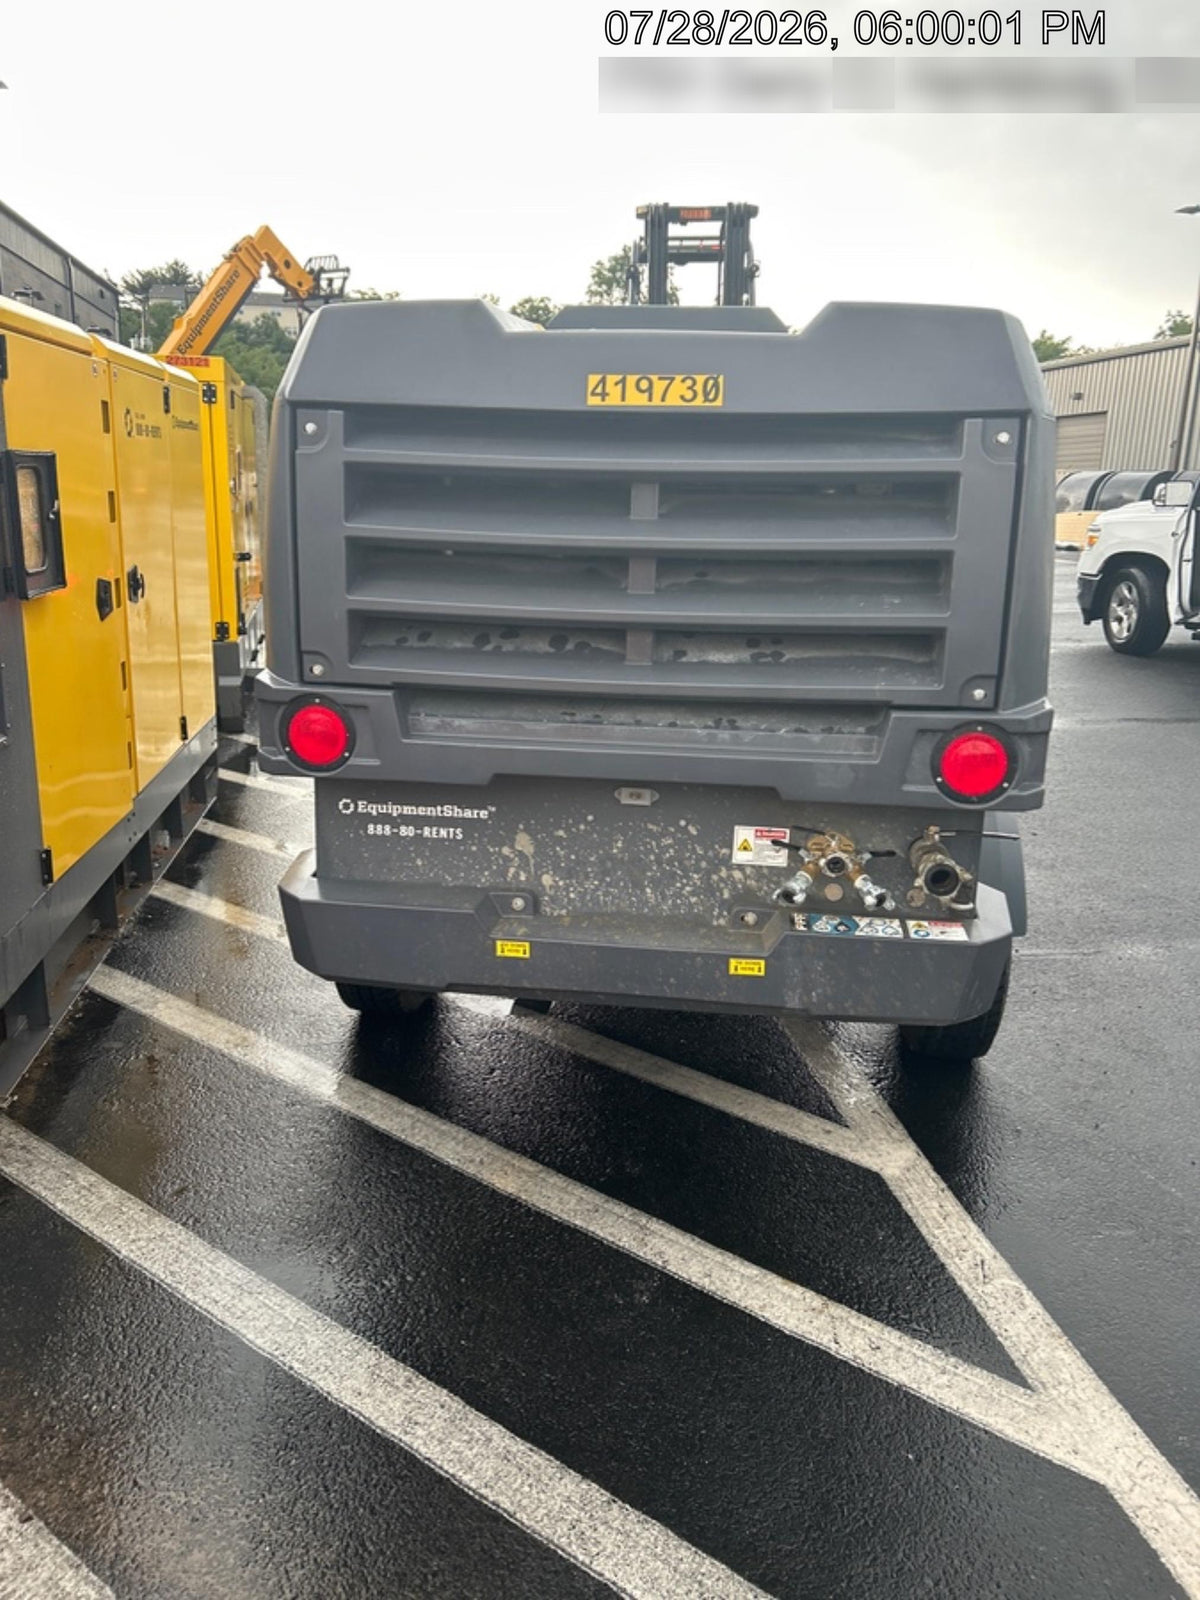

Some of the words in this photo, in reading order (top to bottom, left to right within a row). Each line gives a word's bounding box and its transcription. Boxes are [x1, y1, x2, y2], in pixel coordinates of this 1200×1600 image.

[177, 269, 240, 355] EquipmentShare
[590, 375, 720, 403] 419730
[367, 823, 464, 840] 888-80-RENTS
